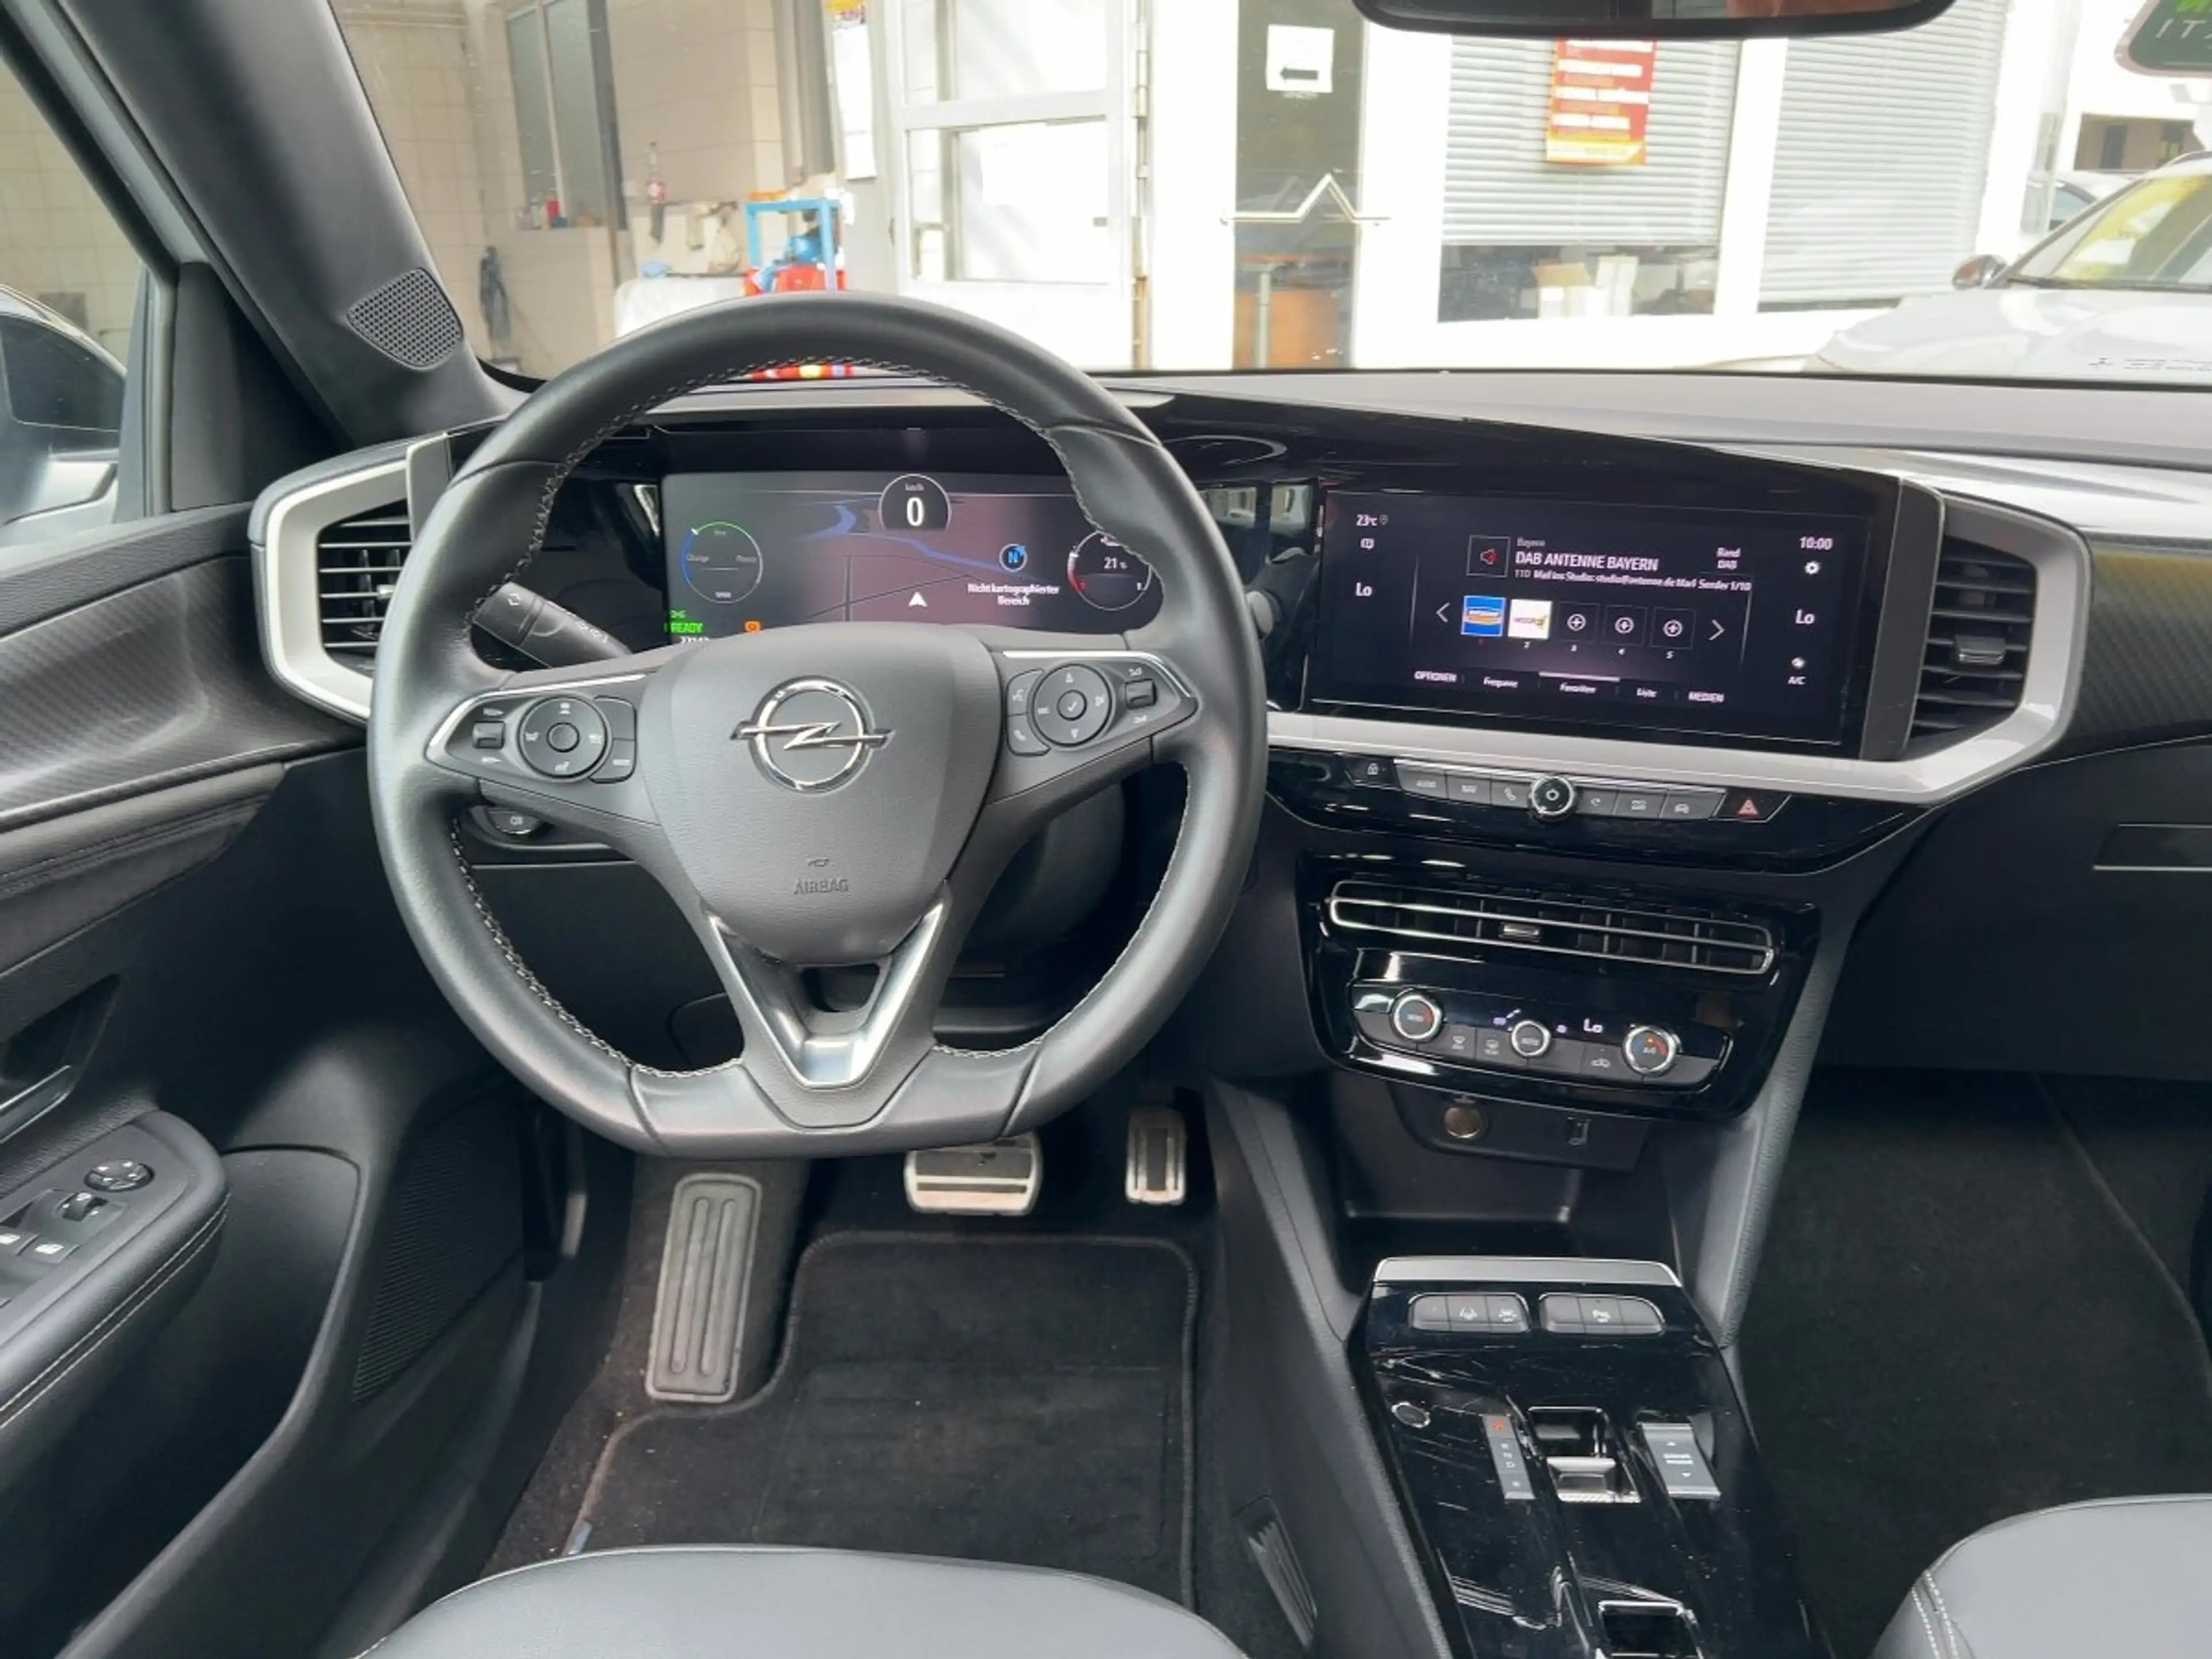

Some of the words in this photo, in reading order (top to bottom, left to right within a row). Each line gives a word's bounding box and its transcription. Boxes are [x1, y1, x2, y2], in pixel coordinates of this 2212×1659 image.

[907, 497, 923, 527] 0
[1800, 536, 1833, 550] 10:00
[1104, 556, 1118, 570] 21
[1515, 551, 1543, 565] DAB
[1544, 553, 1606, 569] ANTENNE
[1607, 556, 1659, 571] BAYERN
[1355, 582, 1373, 596] Lo
[1795, 608, 1815, 624] Lo
[671, 622, 704, 634] READY
[1414, 671, 1457, 683] OPTIONEN
[794, 877, 850, 895] AIRBAG
[1584, 1017, 1604, 1033] Lo
